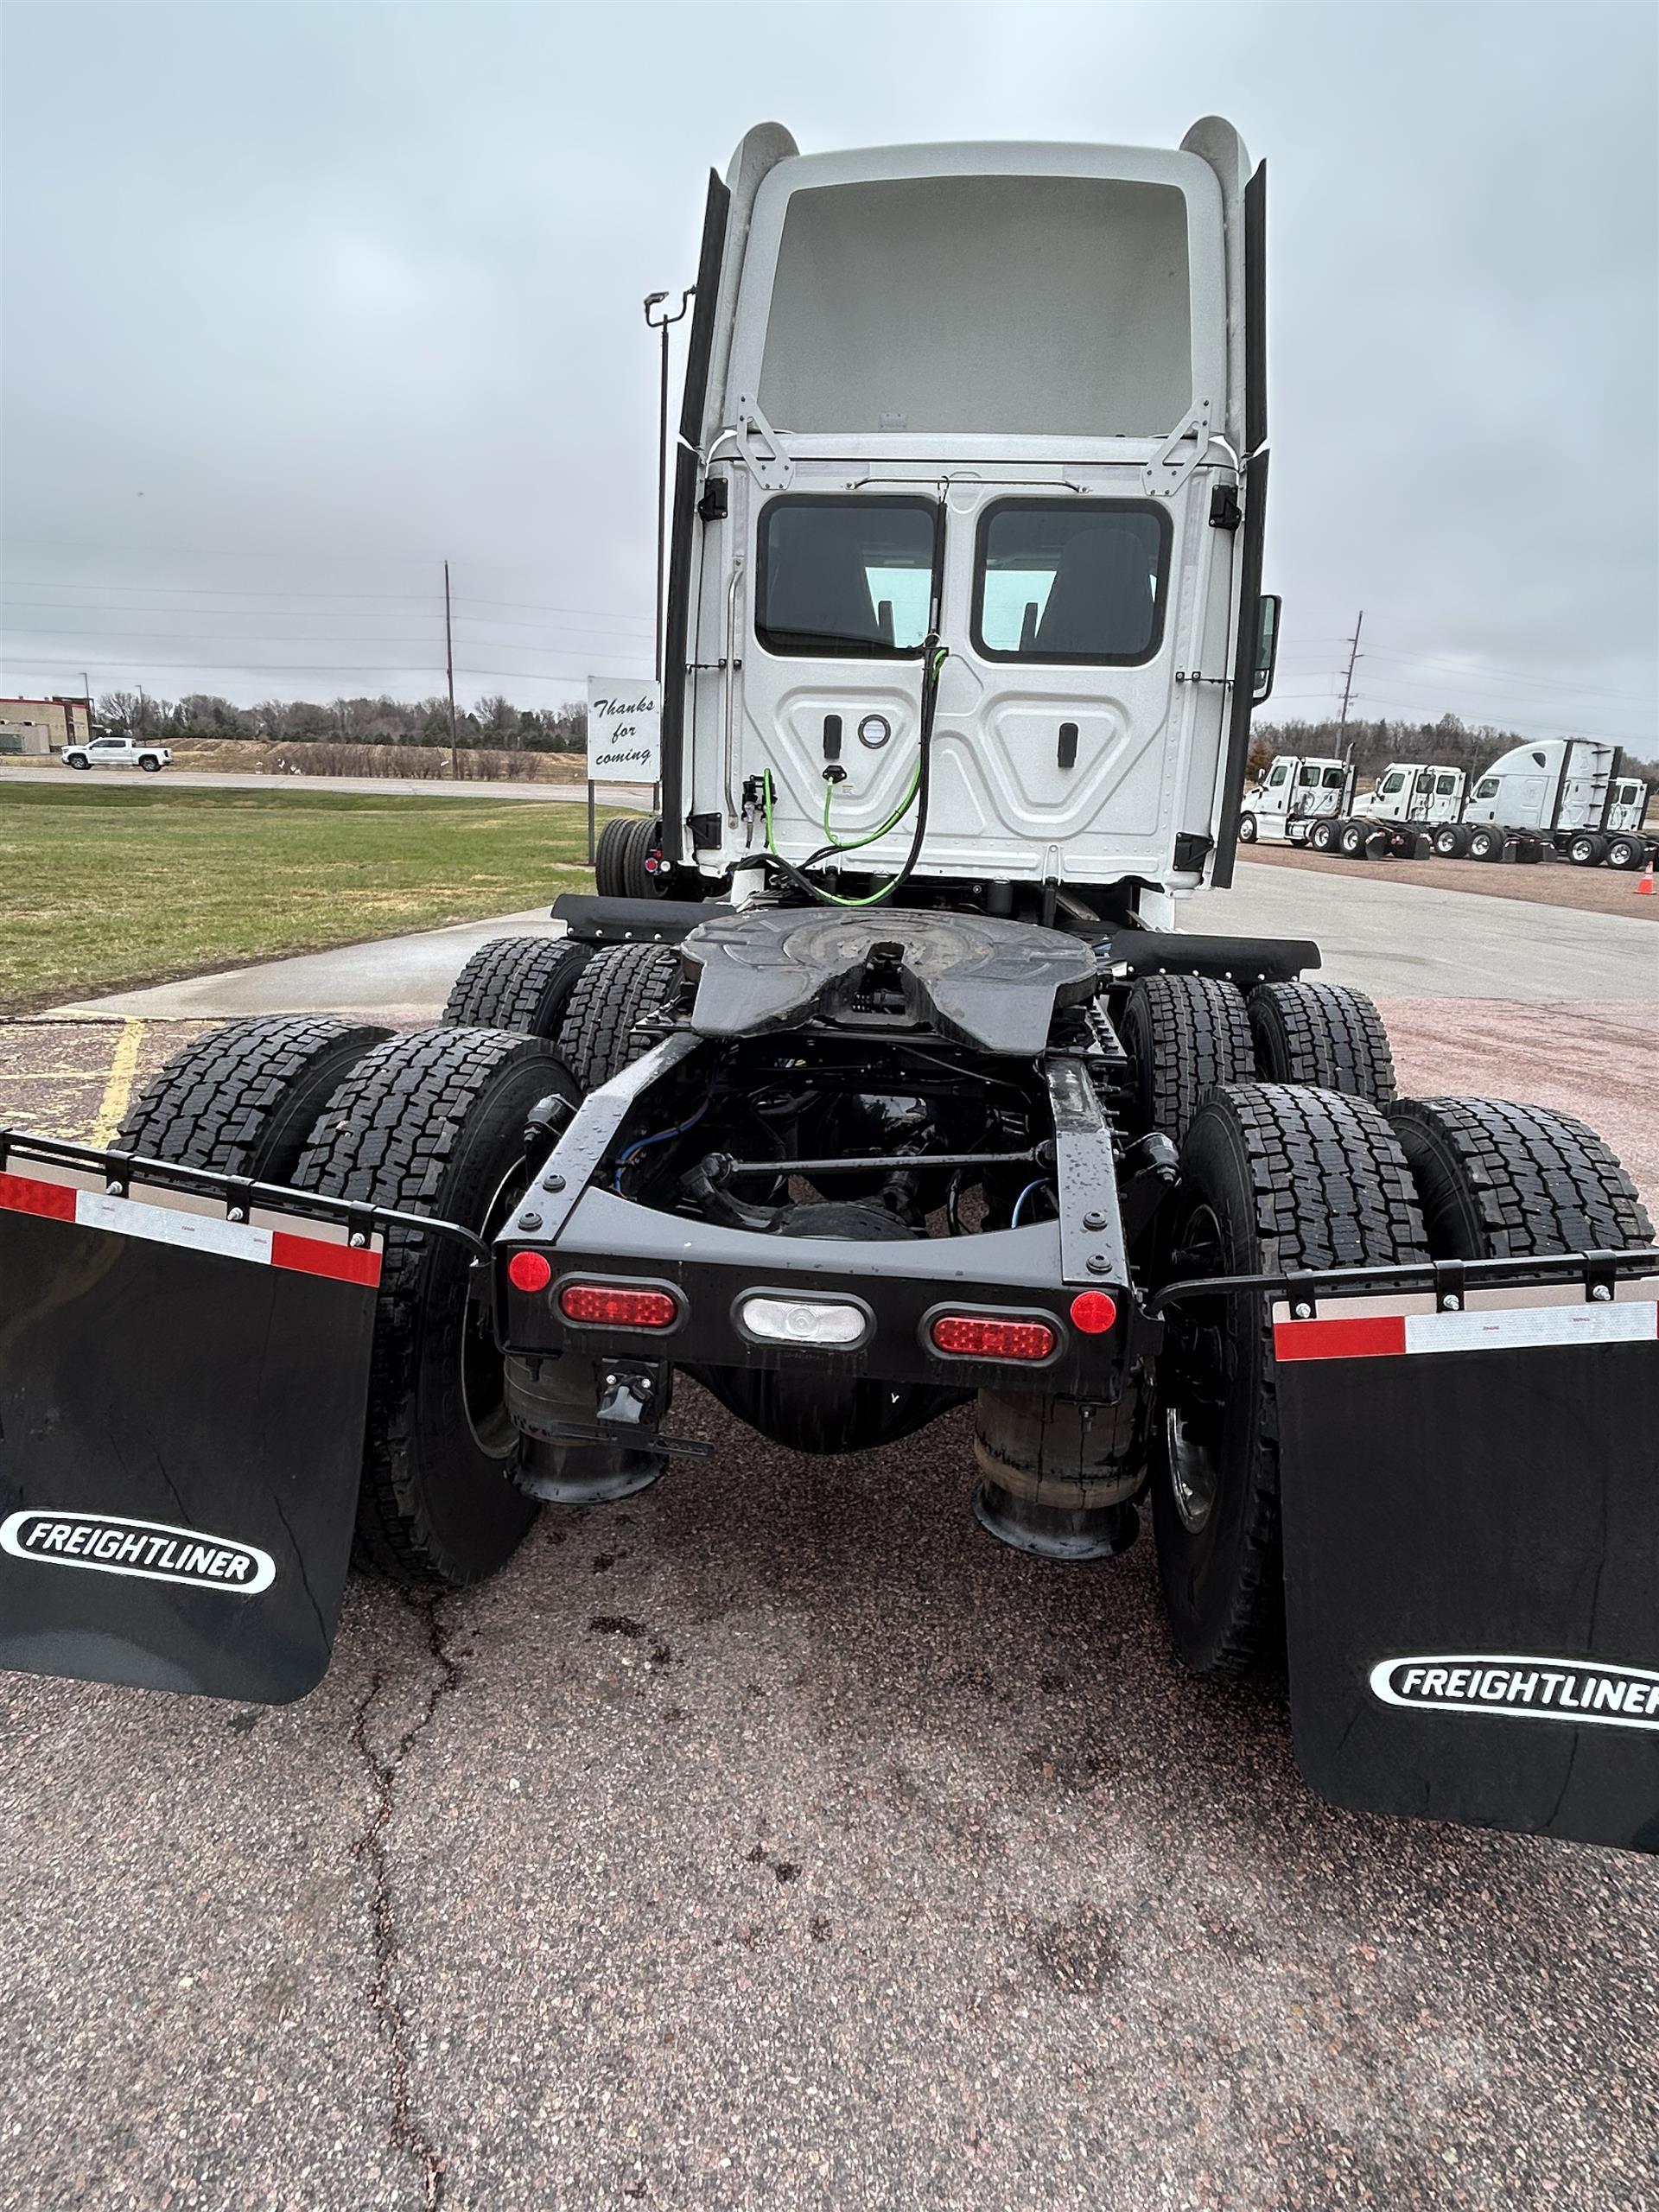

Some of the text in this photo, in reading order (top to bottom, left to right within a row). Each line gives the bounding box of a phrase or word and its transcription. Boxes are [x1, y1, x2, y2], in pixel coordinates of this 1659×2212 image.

[594, 696, 655, 718] Thanks
[612, 722, 637, 744] for
[595, 748, 652, 766] coming
[26, 1522, 251, 1580] FREIGHTLINER
